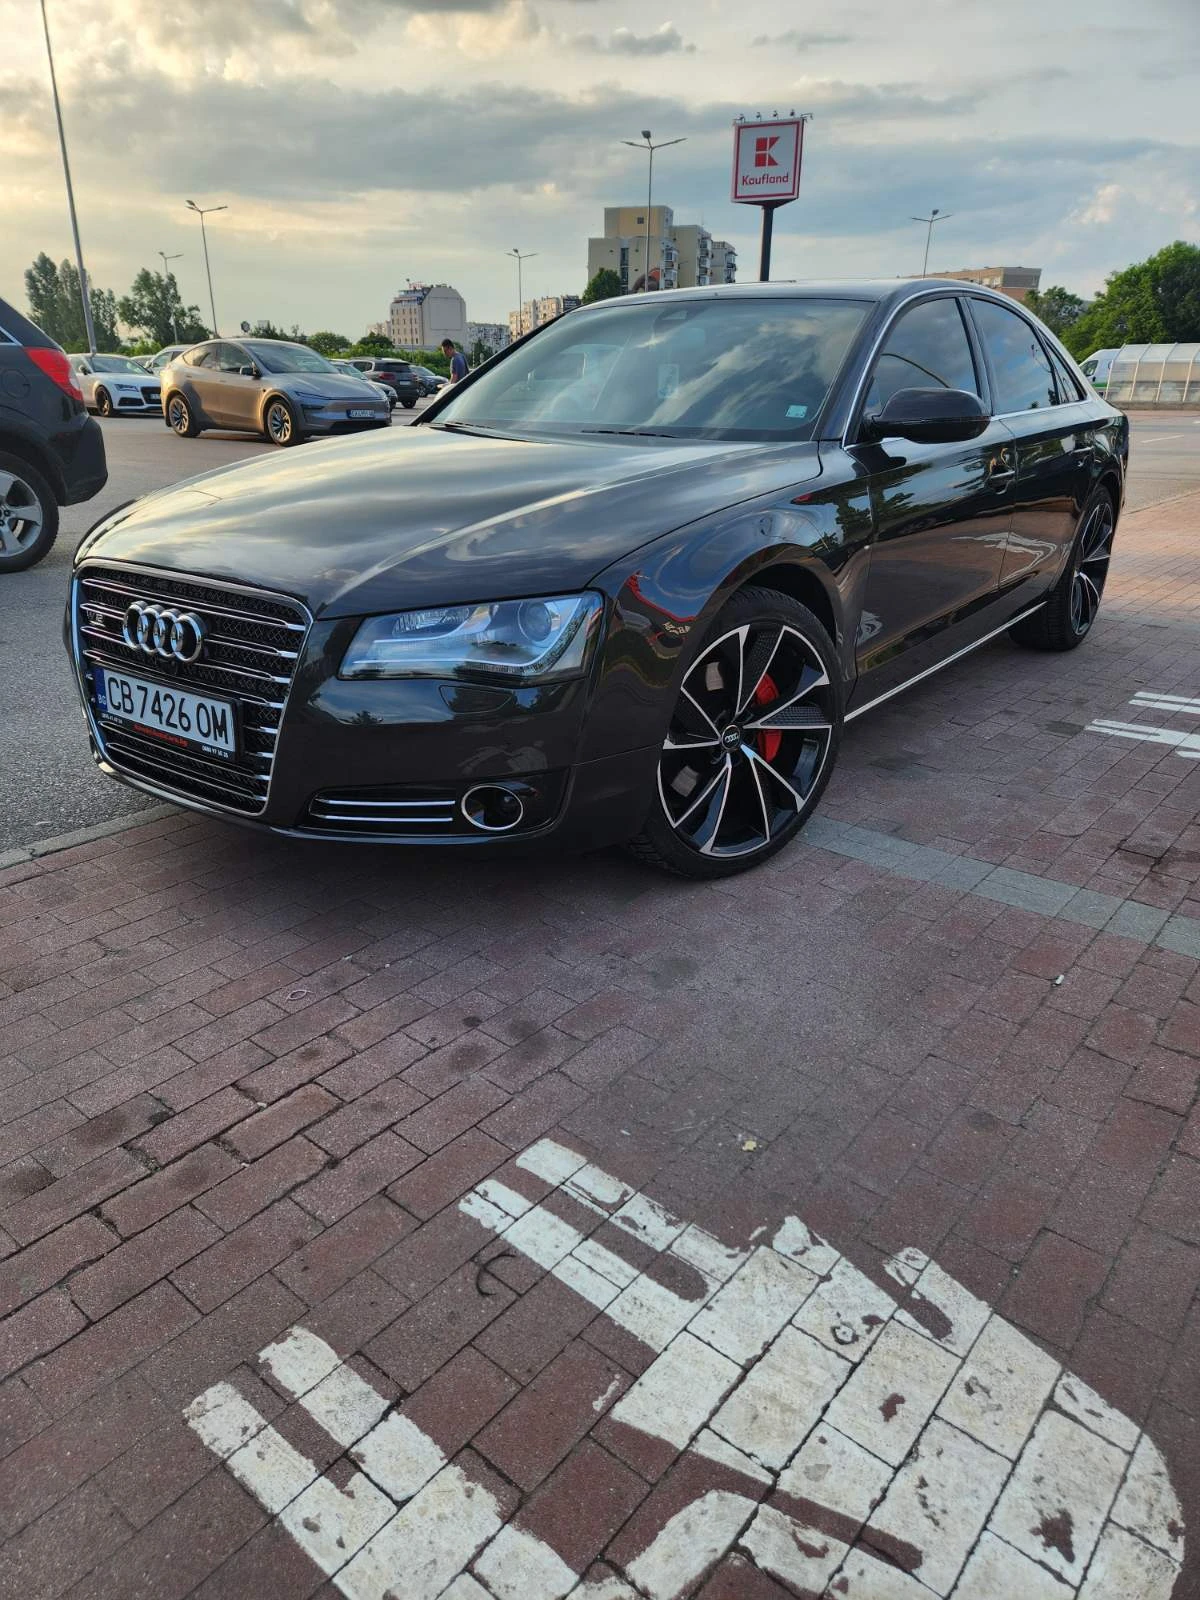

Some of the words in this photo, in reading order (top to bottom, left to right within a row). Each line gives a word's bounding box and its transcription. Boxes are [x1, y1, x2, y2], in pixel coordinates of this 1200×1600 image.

[755, 136, 780, 167] K
[742, 172, 789, 186] Kaufland
[98, 694, 106, 705] BG
